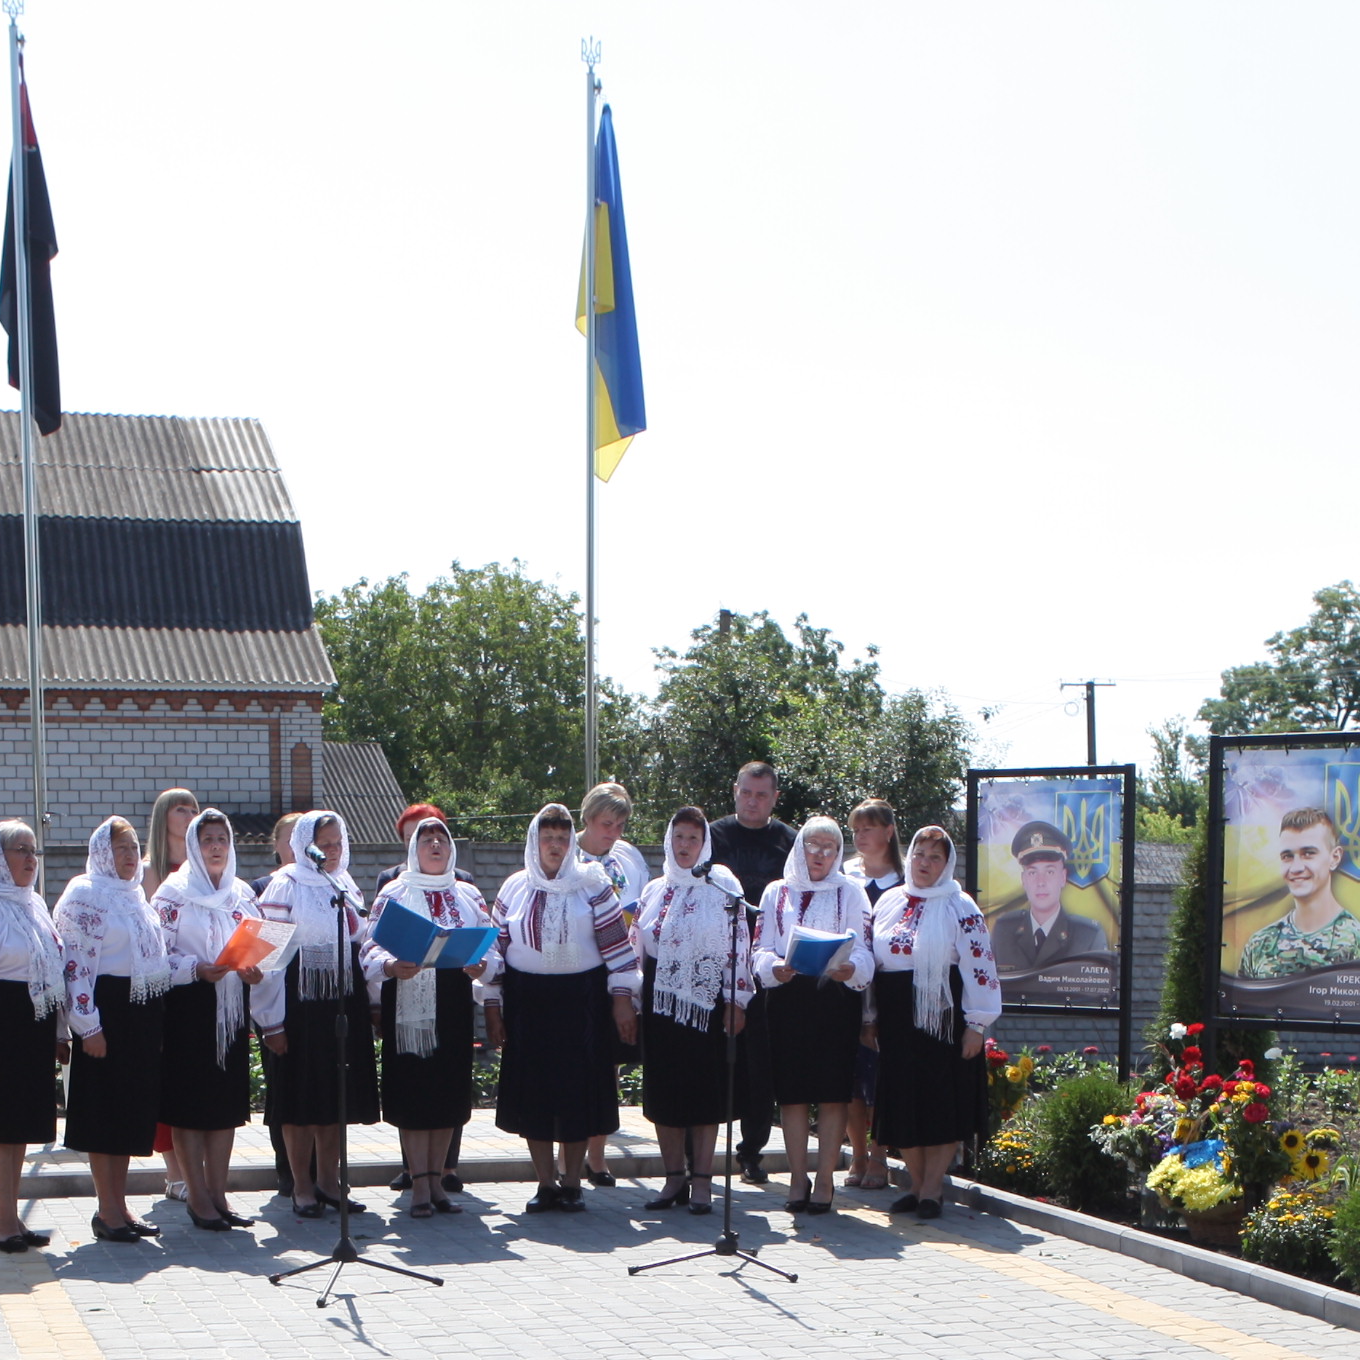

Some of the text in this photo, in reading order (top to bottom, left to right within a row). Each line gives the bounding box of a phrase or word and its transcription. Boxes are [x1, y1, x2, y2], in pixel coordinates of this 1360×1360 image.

[1080, 966, 1110, 975] ГАЛЕТА
[1038, 975, 1110, 984] Вадим Миколайович
[1309, 985, 1327, 995] Ігор
